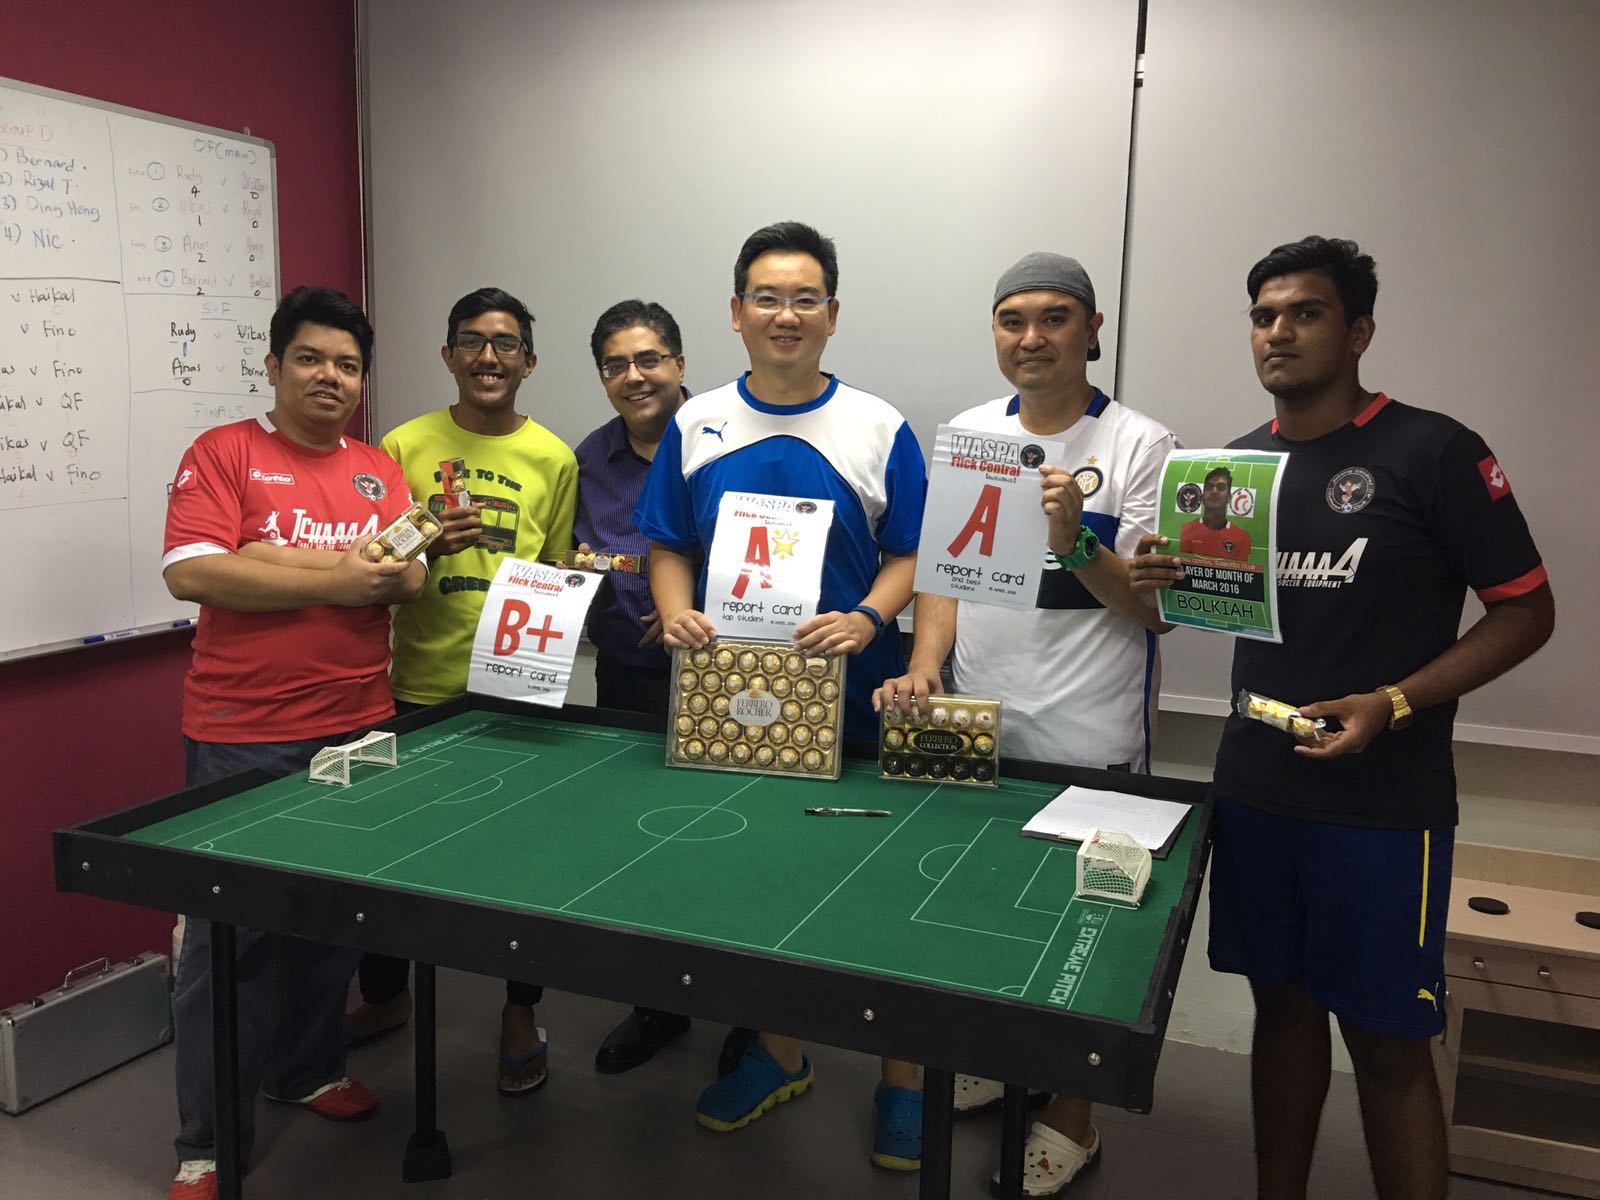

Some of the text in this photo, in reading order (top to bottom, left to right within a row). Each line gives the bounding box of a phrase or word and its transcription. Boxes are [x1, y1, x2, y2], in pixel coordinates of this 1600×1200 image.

[16, 146, 74, 172] Bernard
[191, 185, 200, 198] 4
[29, 285, 76, 304] Haikal
[43, 320, 77, 338] Fino
[170, 321, 197, 343] Rudy
[53, 360, 83, 378] Fino
[249, 384, 259, 393] 2
[61, 392, 83, 411] QF
[193, 402, 247, 419] FINALS
[62, 429, 91, 452] QF
[951, 434, 1020, 466] WASPA
[65, 463, 103, 486] Fino
[951, 455, 1021, 477] Flick Central
[476, 469, 494, 482] TO
[497, 474, 522, 492] THE
[947, 484, 1002, 558] A
[936, 562, 1025, 586] report card
[1185, 565, 1254, 583] AYER OF MONTH OF
[1191, 578, 1240, 595] MARCH 2016
[1278, 579, 1342, 589] SOCCER EQUIPMENT
[722, 601, 802, 616] report card
[1177, 594, 1254, 619] BOLKIAH
[493, 598, 563, 657] B+
[722, 613, 764, 623] top student
[485, 662, 558, 684] report card
[736, 698, 773, 709] FERRERO
[736, 706, 772, 717] ROCHER
[920, 742, 957, 750] COLLECTION
[1063, 926, 1098, 973] EXTREME
[1047, 973, 1077, 1005] PITCH
